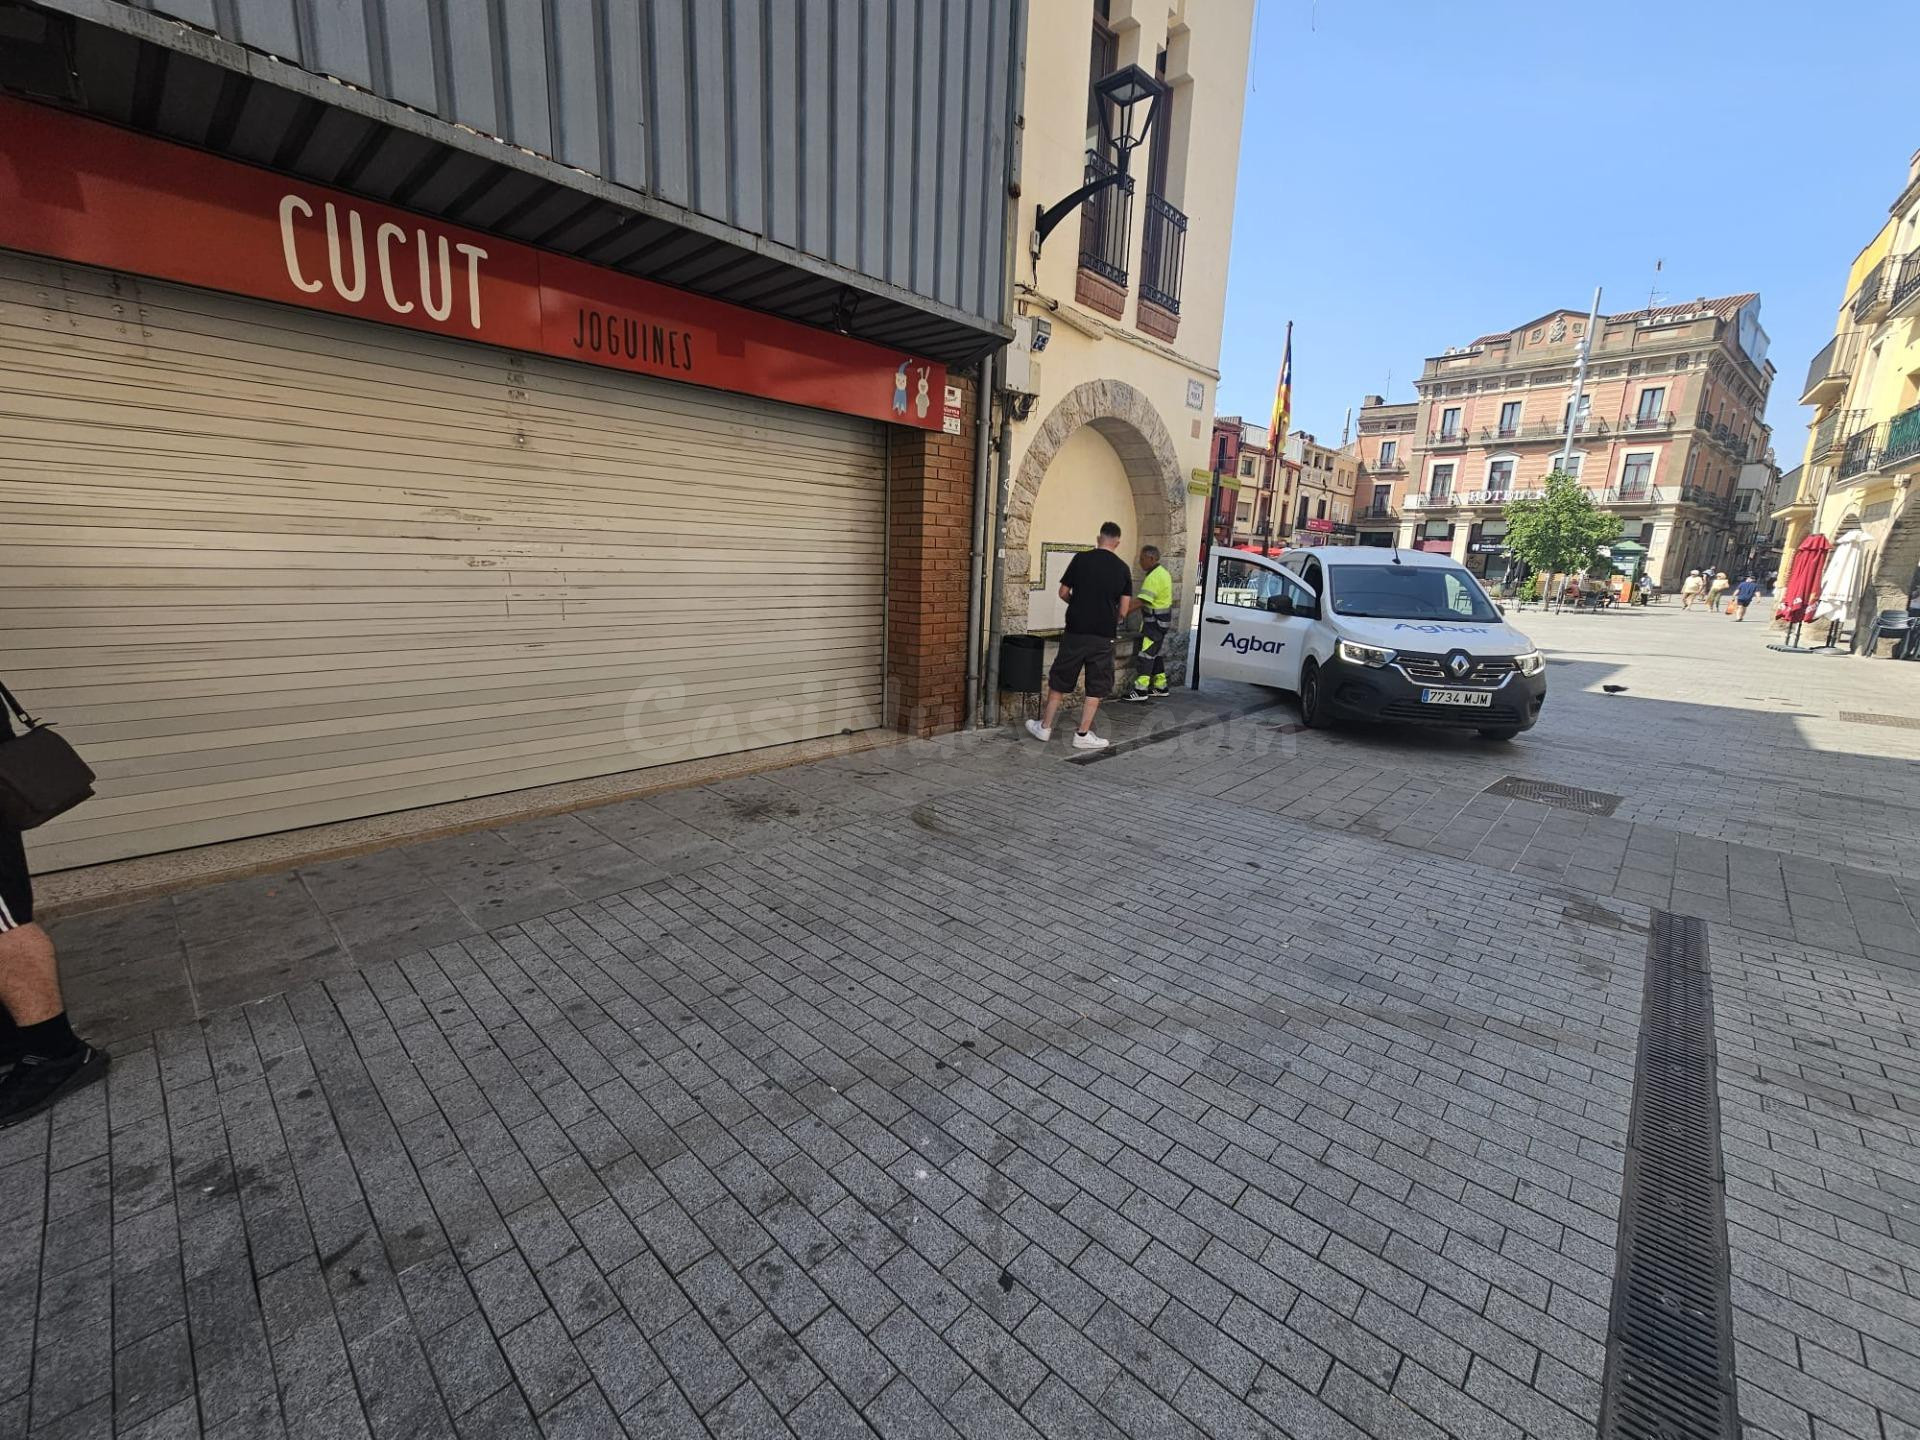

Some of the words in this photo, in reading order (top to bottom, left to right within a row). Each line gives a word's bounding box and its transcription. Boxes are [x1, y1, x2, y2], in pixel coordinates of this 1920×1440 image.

[279, 194, 488, 329] CUCUT
[573, 309, 692, 371] JOGUINES
[1394, 623, 1488, 634] Agbar
[1220, 632, 1285, 655] Agbar
[1430, 691, 1460, 703] 7734
[1463, 693, 1489, 705] MJM
